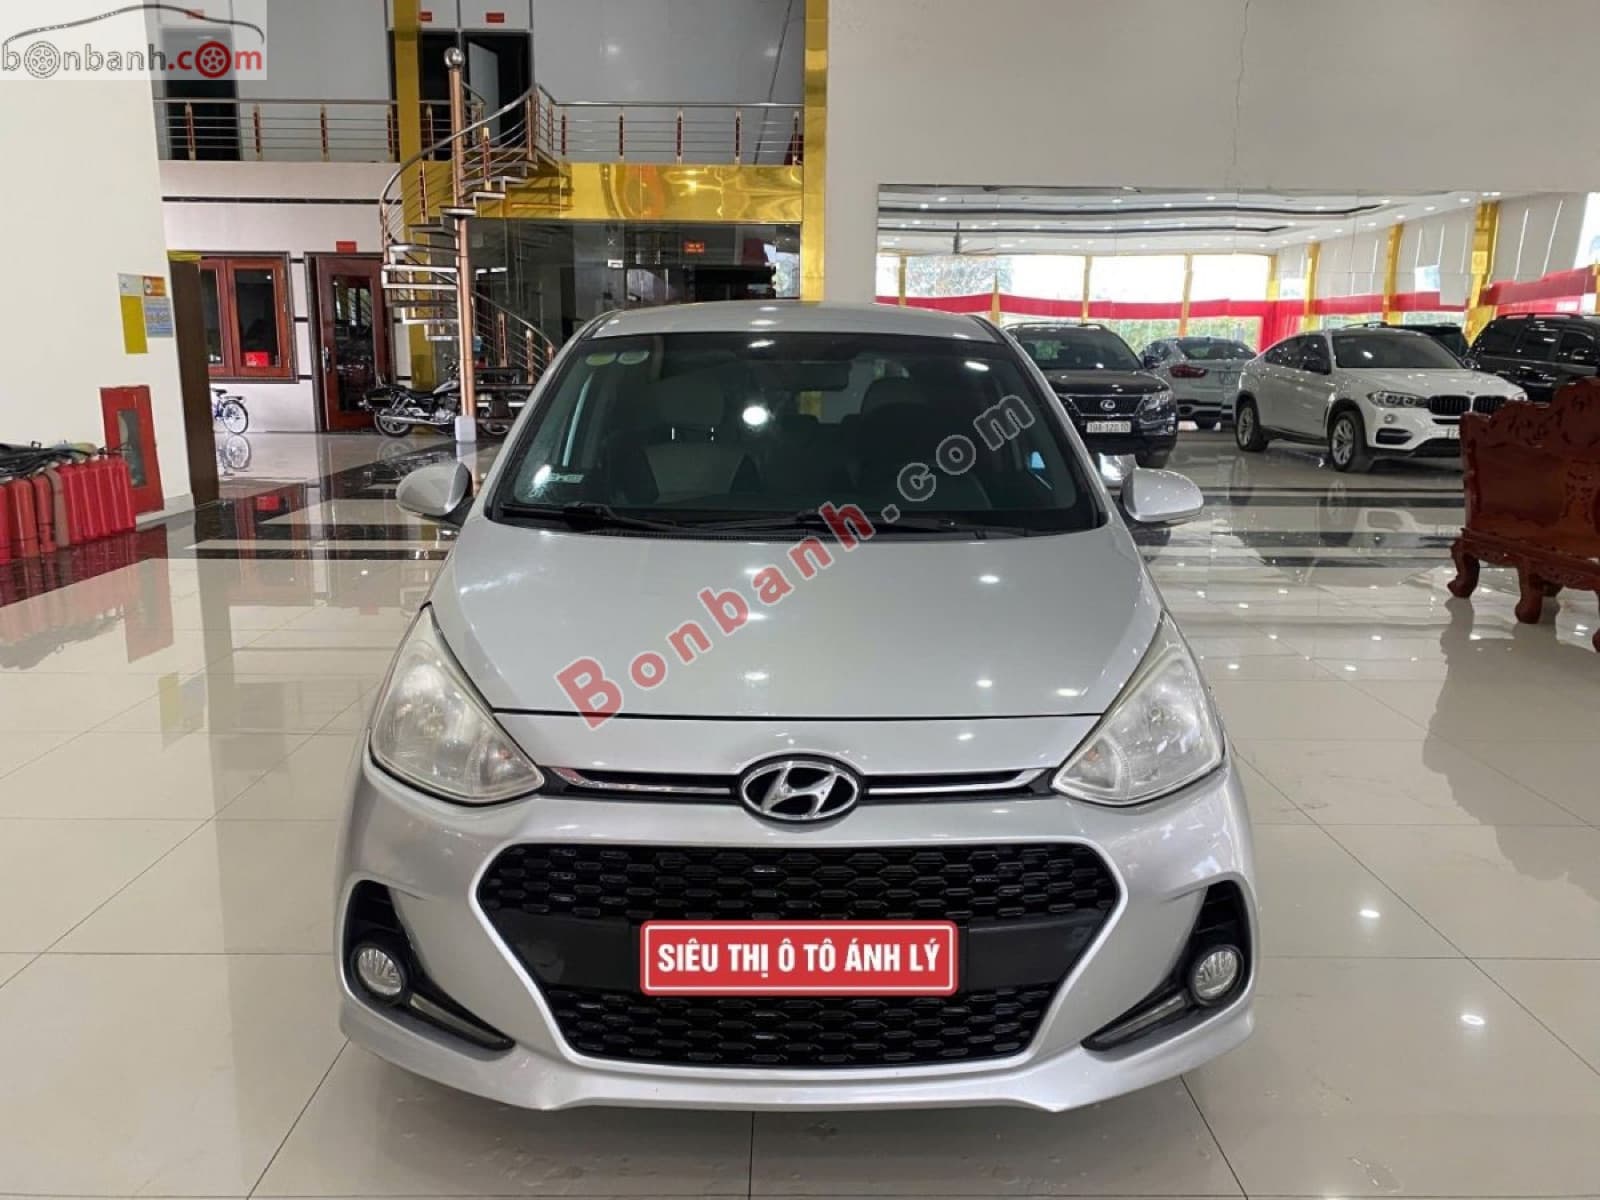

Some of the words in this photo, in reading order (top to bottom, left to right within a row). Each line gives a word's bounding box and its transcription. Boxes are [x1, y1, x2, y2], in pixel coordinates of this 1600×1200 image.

[657, 938, 719, 972] SIÊU
[728, 943, 769, 978] THỊ
[777, 938, 796, 972] Ô
[803, 938, 837, 972] TÔ
[844, 938, 901, 972] ÁNH
[909, 938, 941, 972] LÝ
